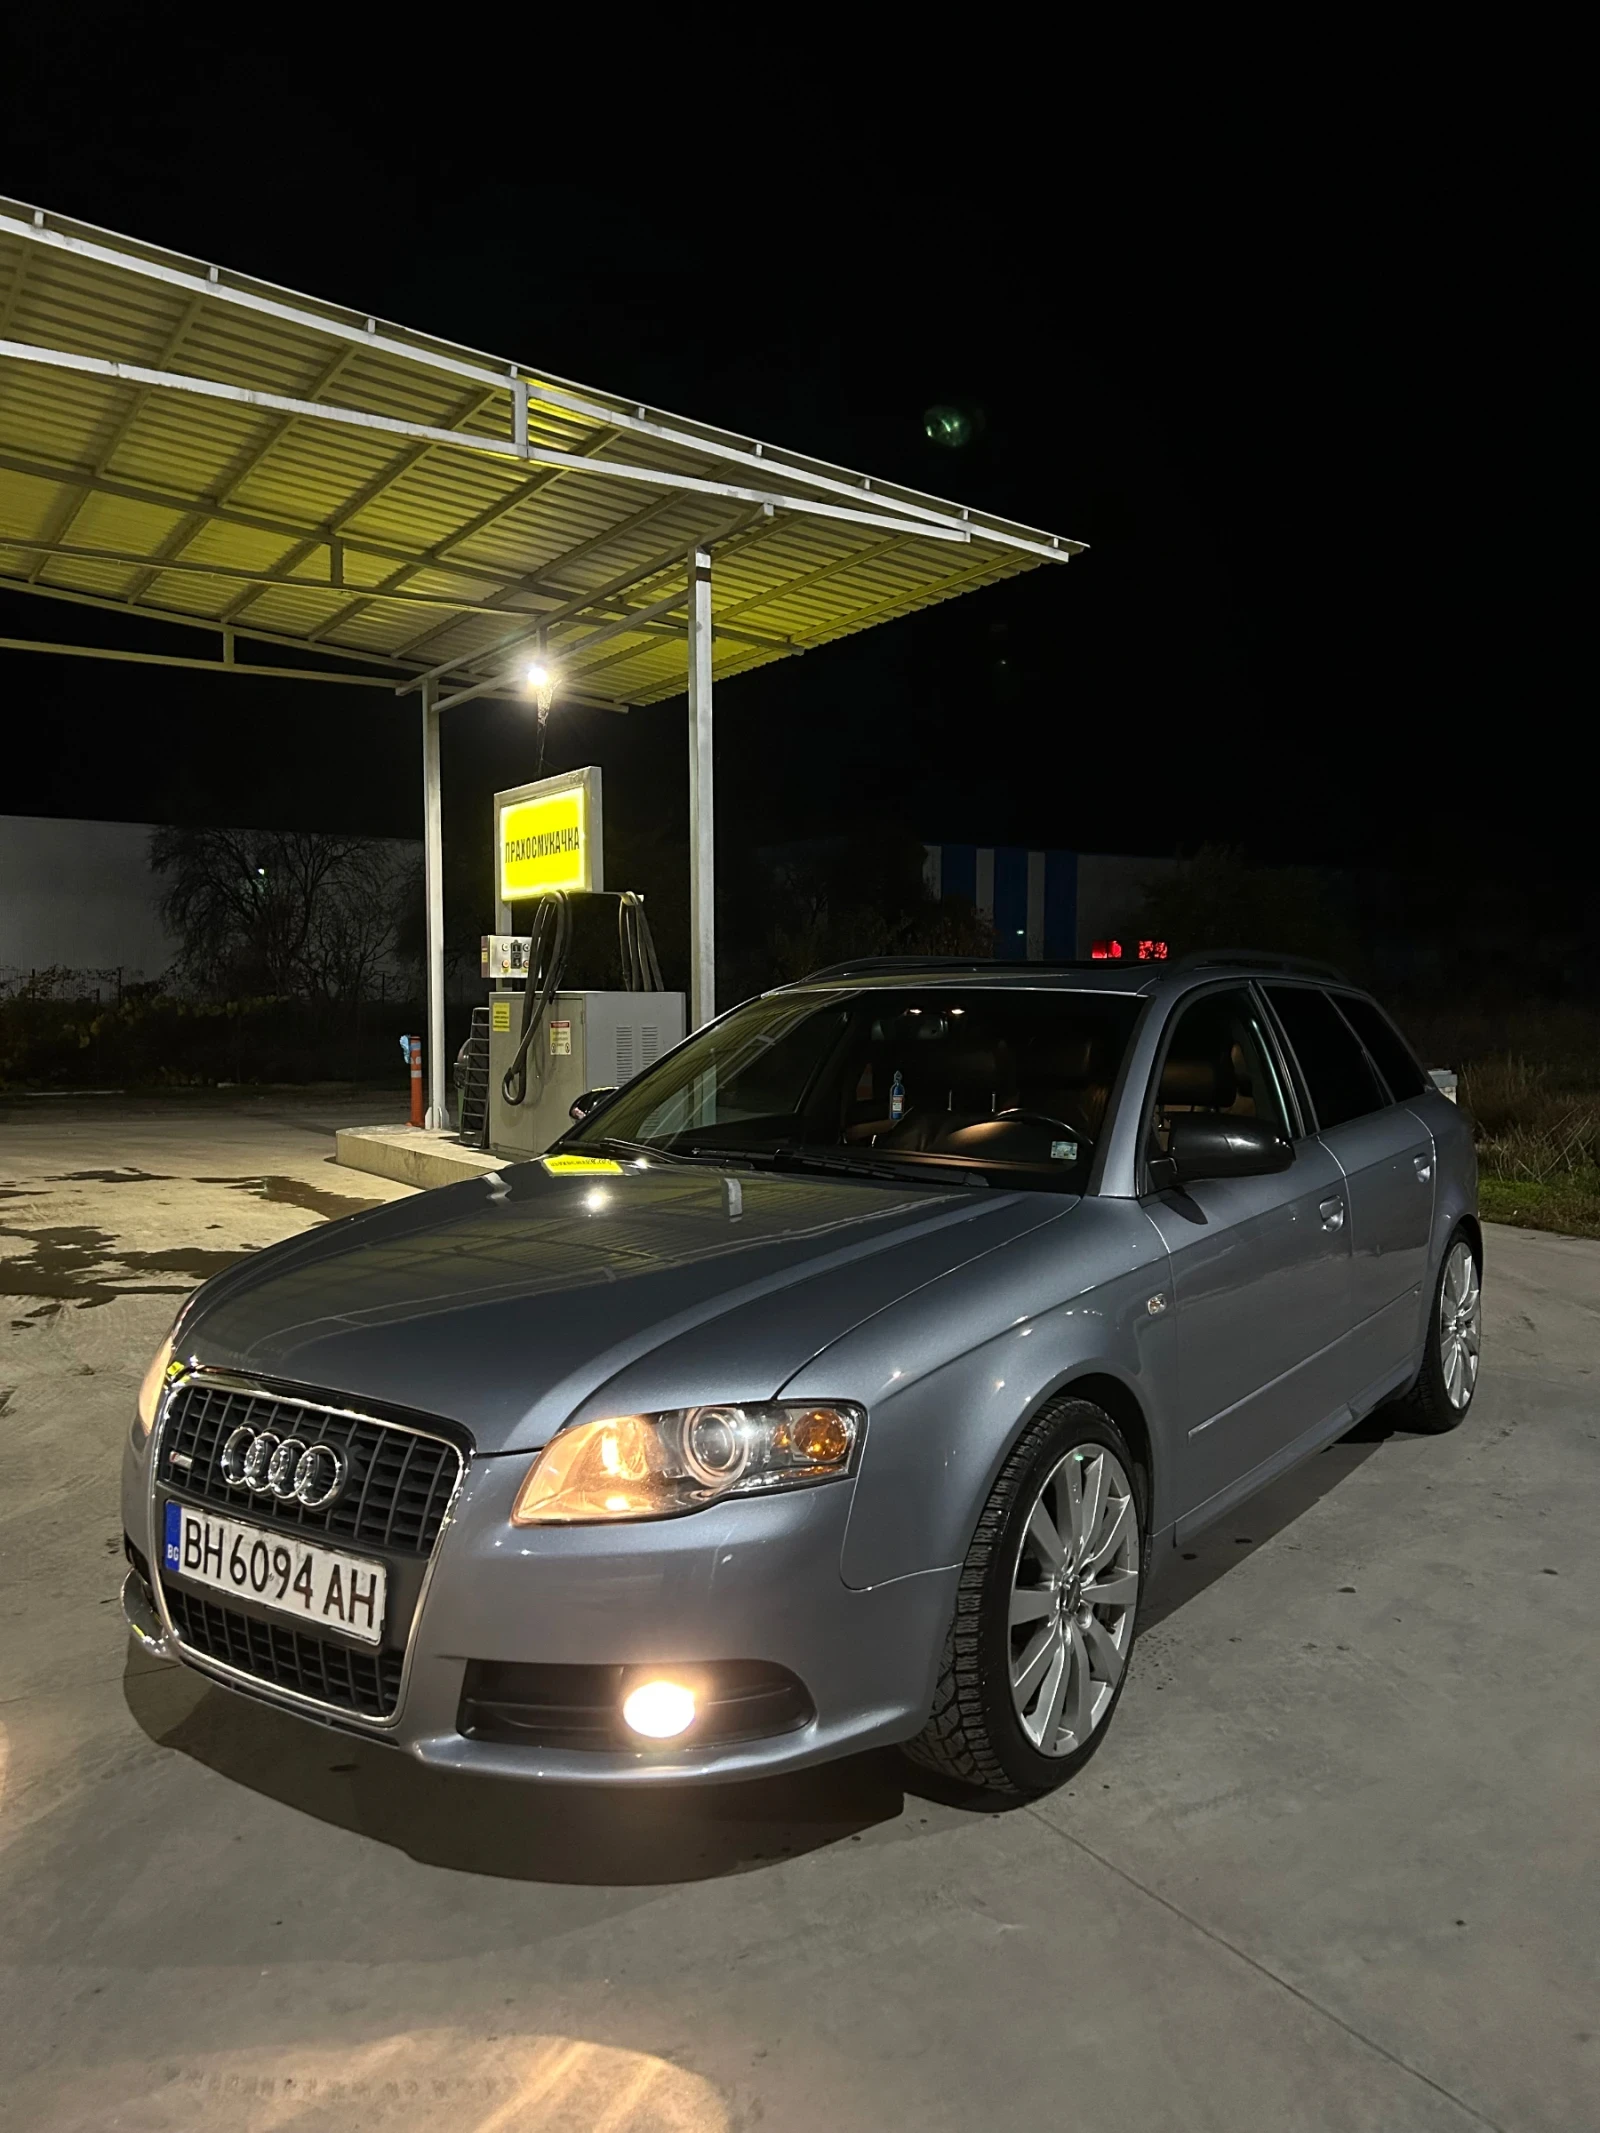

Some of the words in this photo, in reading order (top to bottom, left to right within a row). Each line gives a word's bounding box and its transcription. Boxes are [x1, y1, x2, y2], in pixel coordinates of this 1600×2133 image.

[505, 826, 579, 864] ПРАХОСМУКАЧКА
[167, 1544, 179, 1561] BG
[323, 1563, 377, 1629] AH
